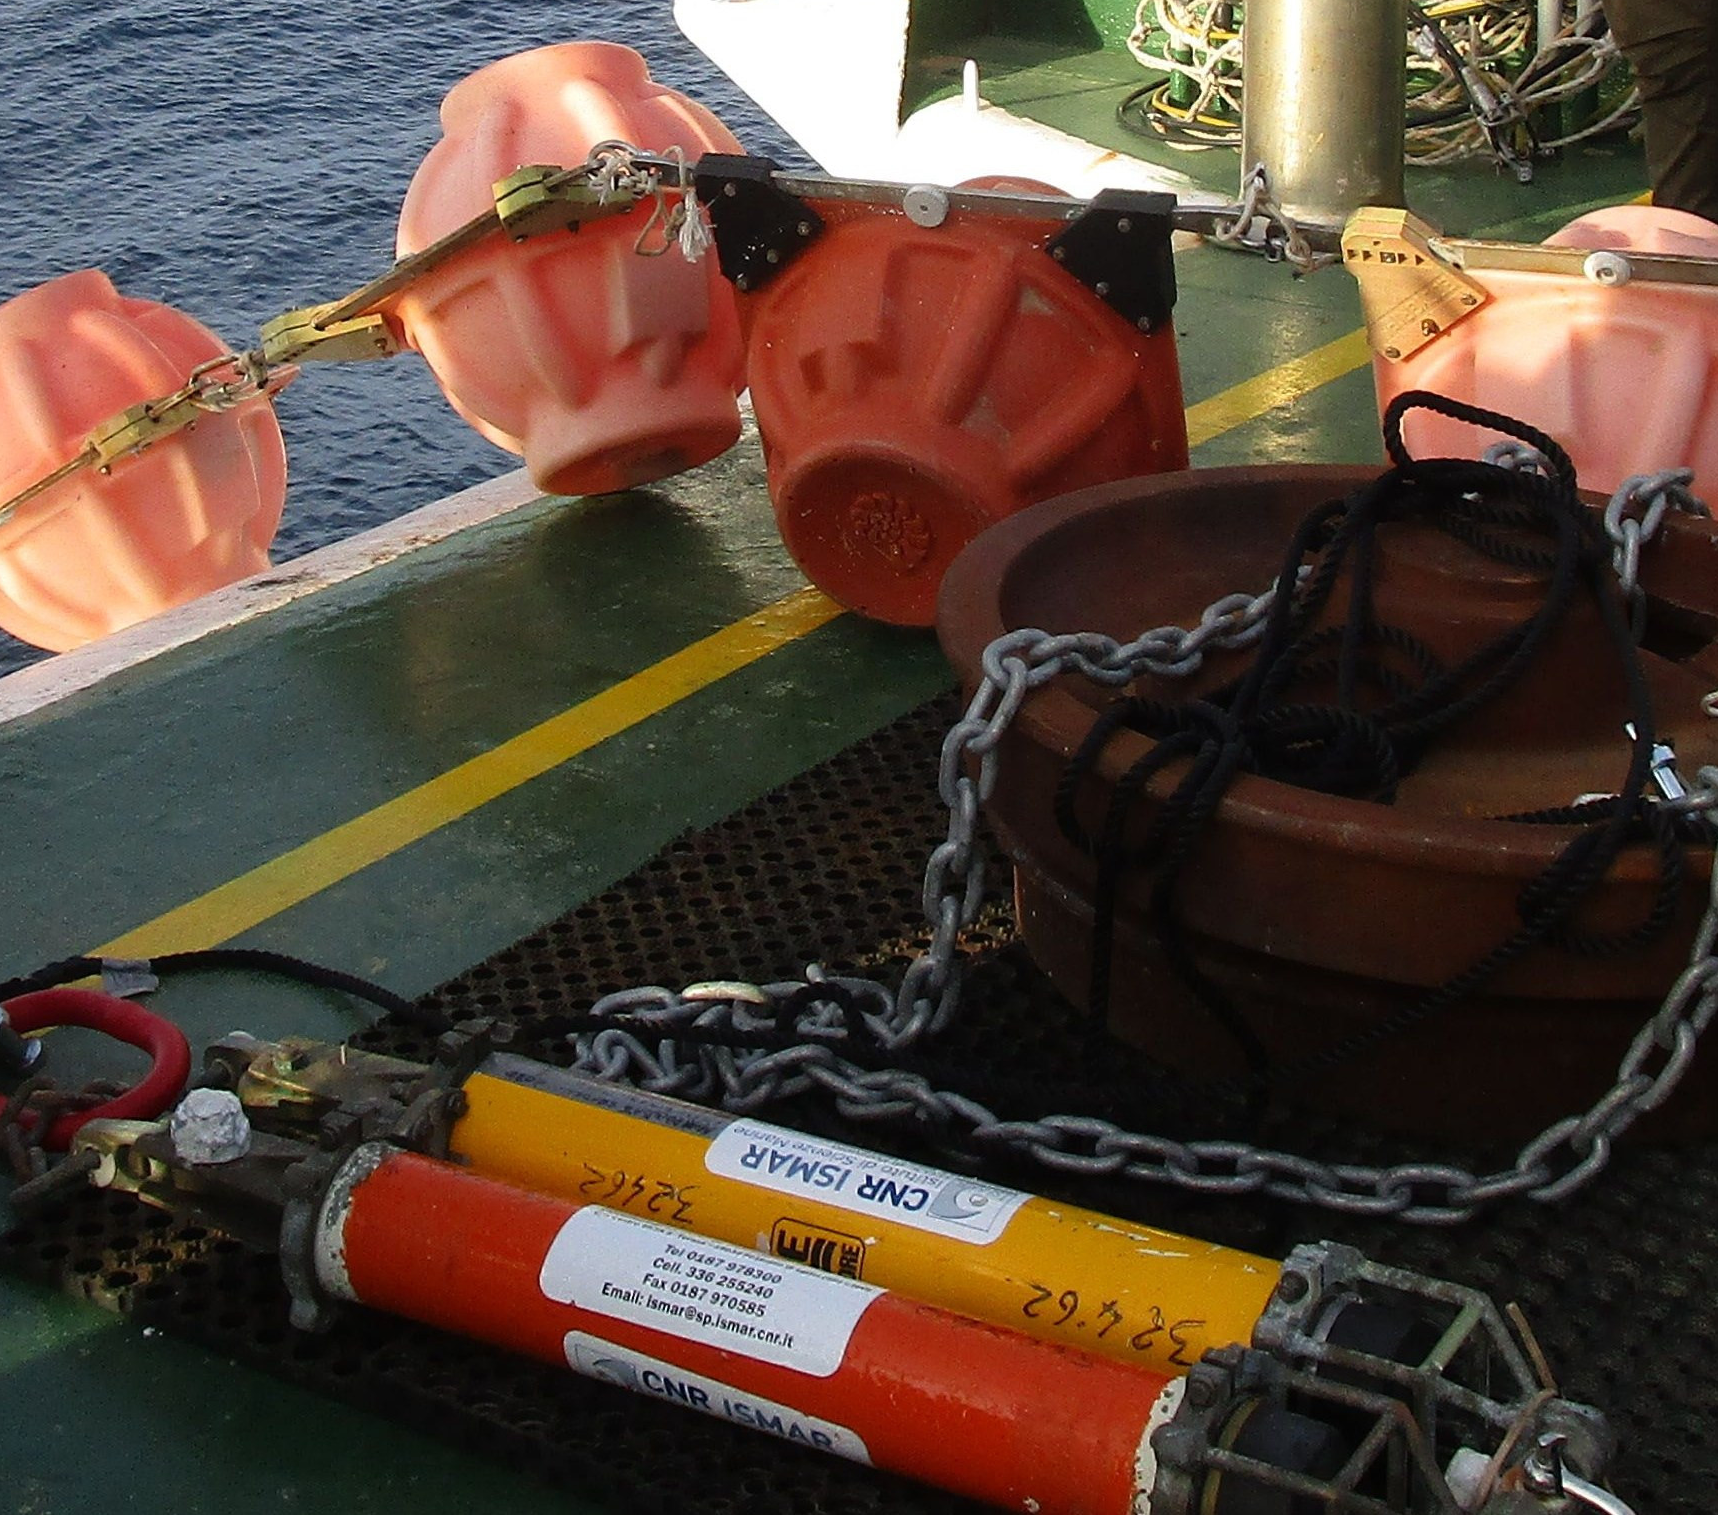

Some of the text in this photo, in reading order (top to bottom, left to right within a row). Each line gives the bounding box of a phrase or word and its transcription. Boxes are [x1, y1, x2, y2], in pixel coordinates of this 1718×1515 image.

[732, 1124, 790, 1149] Marine
[792, 1140, 856, 1167] Scienze
[739, 1143, 852, 1192] ISMAR
[857, 1159, 877, 1175] di
[577, 1162, 701, 1226] 32462
[856, 1173, 930, 1213] CNR
[652, 1256, 775, 1300] Cell. 336 255240
[663, 1243, 783, 1285] Tel 0187 978300
[601, 1281, 795, 1349] Email: ismar@sp.ismar.cnr.it
[641, 1273, 767, 1318] Fax 0187 970585
[641, 1369, 837, 1453] CNR ISMAR
